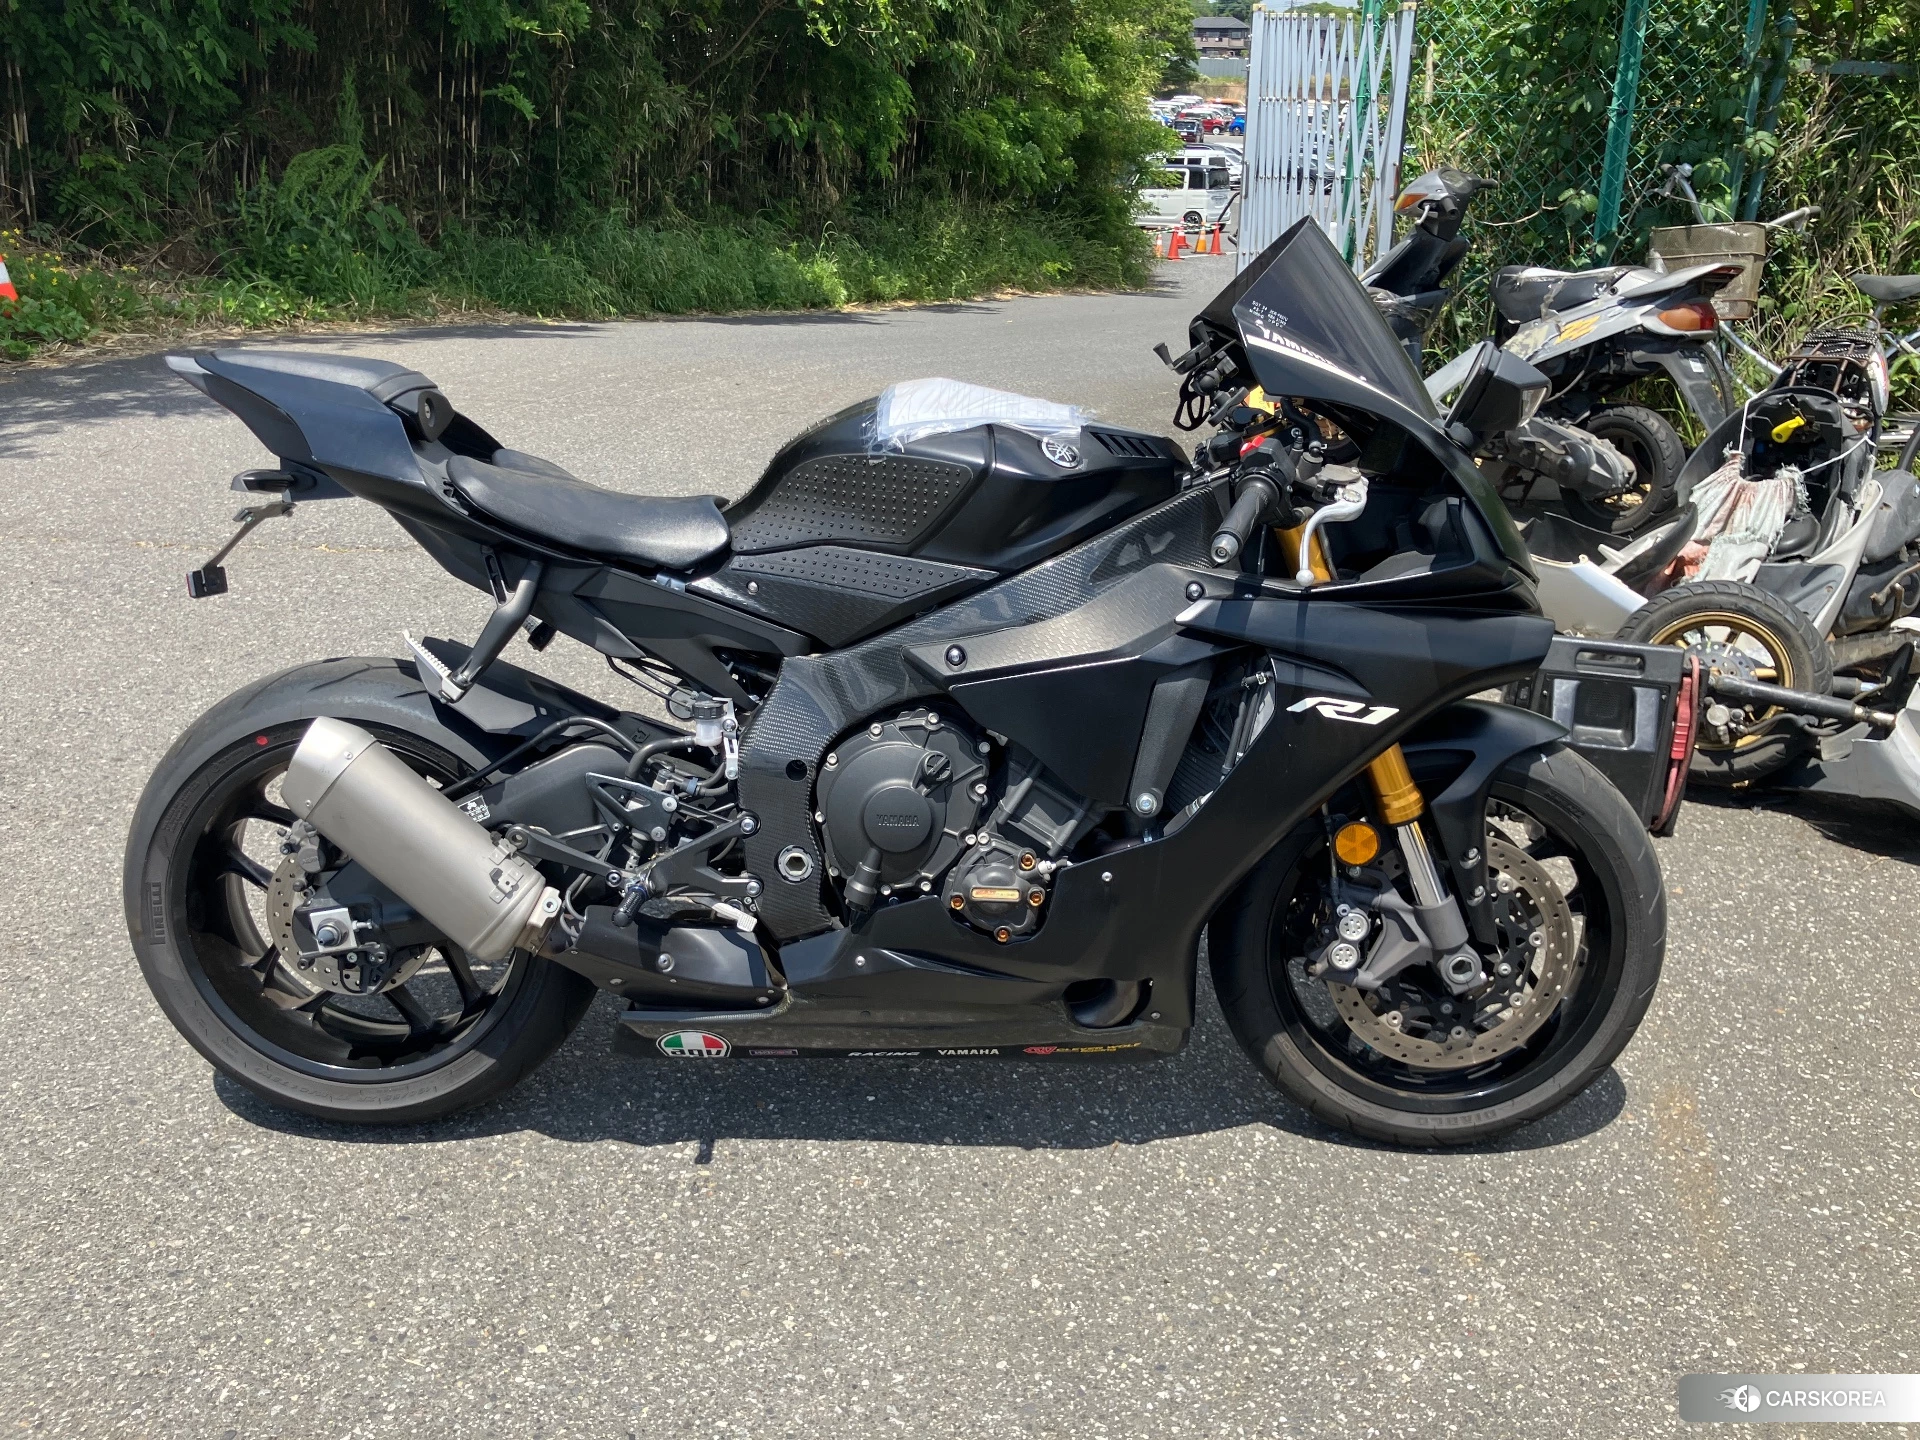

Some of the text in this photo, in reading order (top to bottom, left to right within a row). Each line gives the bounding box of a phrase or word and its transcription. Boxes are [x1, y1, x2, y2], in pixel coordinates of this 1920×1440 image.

[1286, 697, 1399, 725] R1
[877, 814, 919, 827] YAMAHA
[938, 1048, 1000, 1056] YAMAHA
